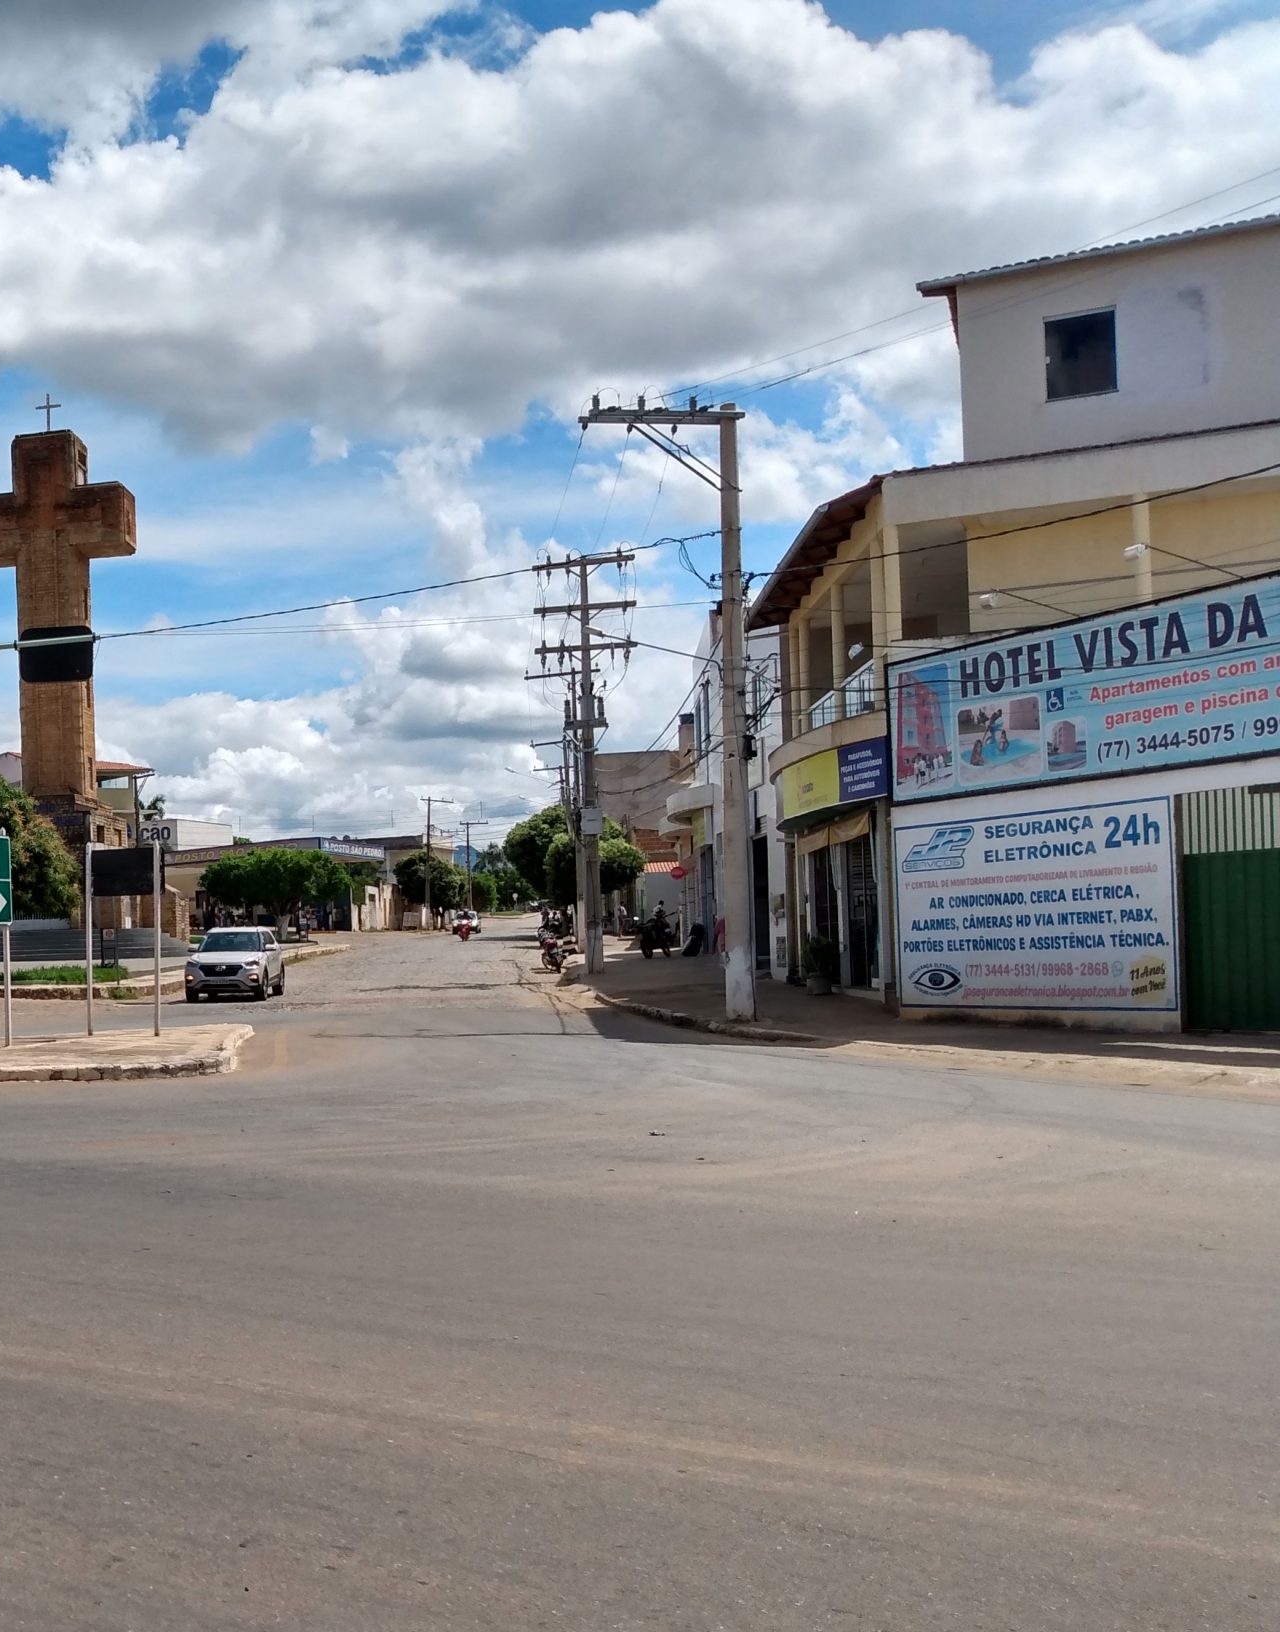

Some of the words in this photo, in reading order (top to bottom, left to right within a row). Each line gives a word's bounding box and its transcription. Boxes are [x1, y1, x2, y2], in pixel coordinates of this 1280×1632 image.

[959, 640, 1062, 698] HOTEL
[1073, 612, 1191, 673] VISTA
[1206, 593, 1269, 649] DA
[1089, 669, 1211, 702] Apartamentos
[1216, 660, 1257, 678] com
[1105, 703, 1179, 729] garagem
[1184, 701, 1195, 714] e
[1201, 688, 1269, 715] piscina
[1097, 739, 1130, 763] (77)
[1136, 723, 1235, 755] 3444-5075
[1253, 716, 1280, 737] 99
[984, 815, 1094, 840] SEGURANÇA
[1103, 812, 1161, 849] 24h
[174, 851, 215, 863] POSTO
[984, 840, 1097, 864] ELETRÔNICA
[929, 897, 945, 909] AR
[948, 891, 1027, 908] CONDICIONADO,
[1030, 888, 1067, 904] CERCA
[911, 918, 960, 932] ALARMES,
[962, 914, 1013, 930] CÂMERAS
[1016, 914, 1032, 927] HD
[1034, 912, 1055, 926] VIA
[1057, 909, 1117, 926] INTERNET,
[1120, 907, 1158, 923] PABX,
[903, 936, 944, 953] PORTÕES
[947, 935, 1016, 952] ELETRÔNICOS
[1019, 937, 1026, 950] E
[1029, 931, 1106, 950] ASSISTÊNCIA
[1109, 929, 1170, 948] TÉCNICA.
[964, 962, 983, 978] (77)
[1140, 963, 1166, 978] Anos
